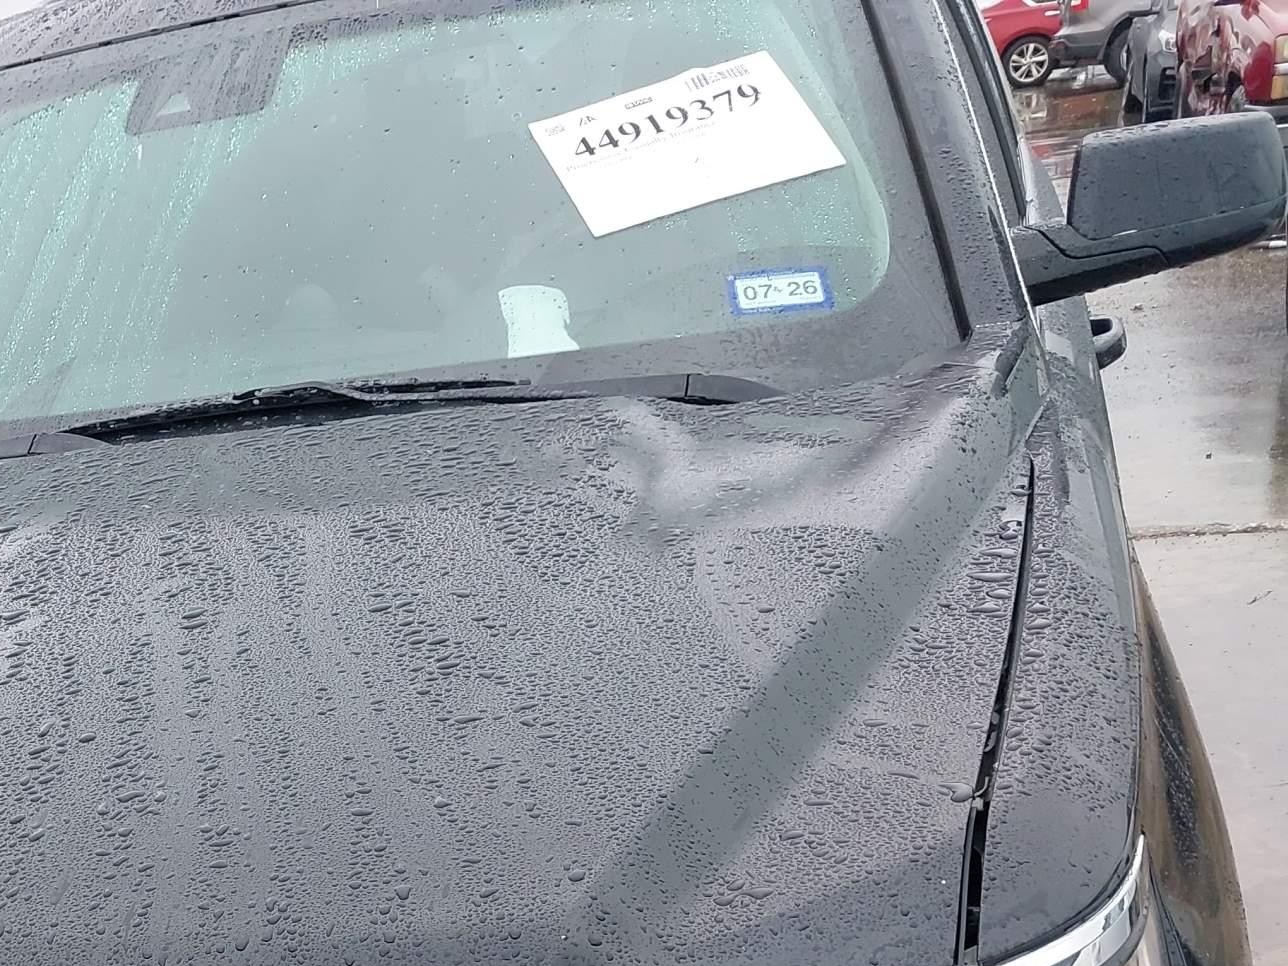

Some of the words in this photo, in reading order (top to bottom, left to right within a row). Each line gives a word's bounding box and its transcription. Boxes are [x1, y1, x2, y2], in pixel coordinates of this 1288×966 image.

[574, 84, 761, 156] 44919379
[743, 284, 773, 301] 07
[787, 280, 818, 297] 26
